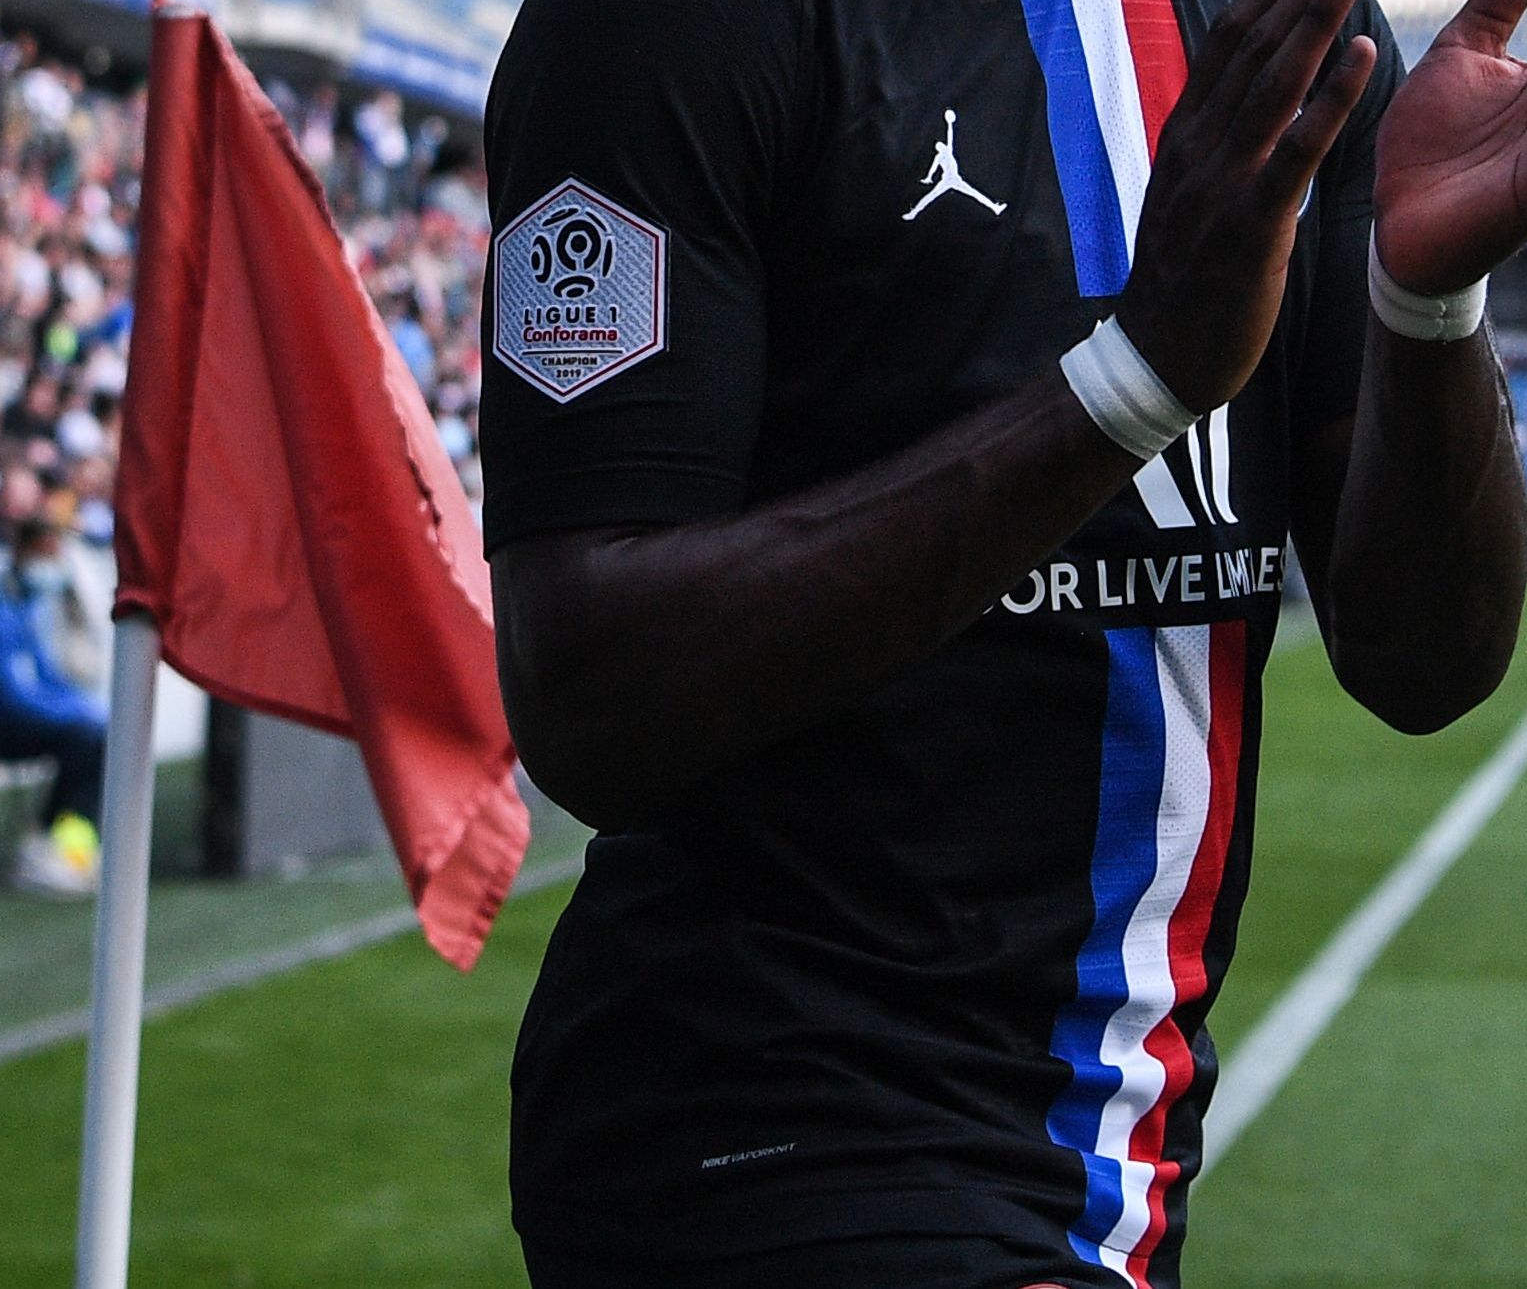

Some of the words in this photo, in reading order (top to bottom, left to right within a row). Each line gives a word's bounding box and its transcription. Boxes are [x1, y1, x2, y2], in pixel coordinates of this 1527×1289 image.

[524, 307, 596, 325] LIGUE
[609, 306, 618, 323] 1
[523, 326, 618, 344] Conforama
[541, 357, 598, 366] CHAMPION
[556, 369, 582, 378] 2019
[983, 562, 1083, 615] OR
[1096, 553, 1206, 607] LIVE
[701, 1154, 731, 1169] NIKE
[731, 1143, 798, 1162] VAPORKNIT
